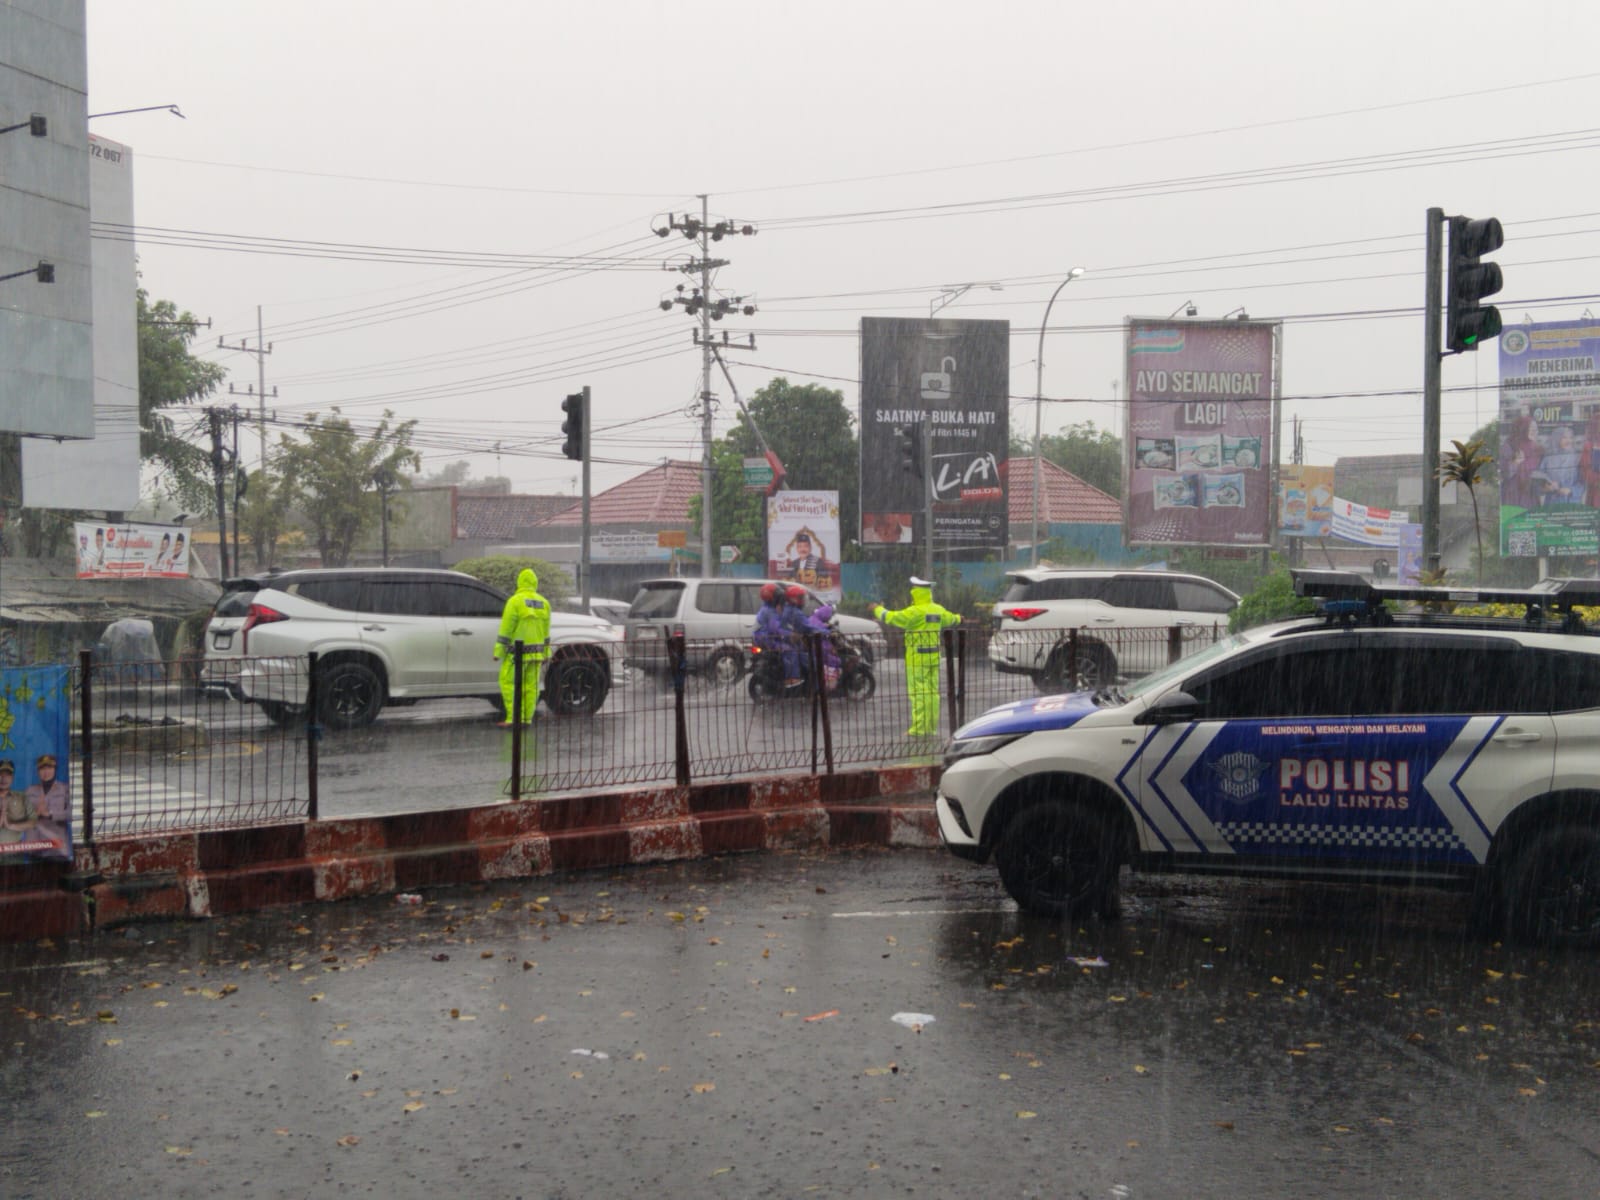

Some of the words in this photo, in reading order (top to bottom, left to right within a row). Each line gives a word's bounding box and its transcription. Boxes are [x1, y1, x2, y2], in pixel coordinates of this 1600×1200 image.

[1528, 357, 1593, 373] MENERIMA
[1136, 370, 1168, 393] AYO
[1172, 371, 1262, 395] SEMANGAT
[932, 410, 965, 424] BUKA
[1184, 402, 1228, 425] LAGI!
[1261, 726, 1314, 735] MELINDUNGI,
[1316, 725, 1365, 734] MENGAYOMI
[1366, 725, 1384, 734] DAN
[1385, 724, 1427, 734] MELAYANI
[1280, 758, 1409, 792] POLISI
[1280, 793, 1331, 807] LALU
[1337, 794, 1409, 809] LINTAS
